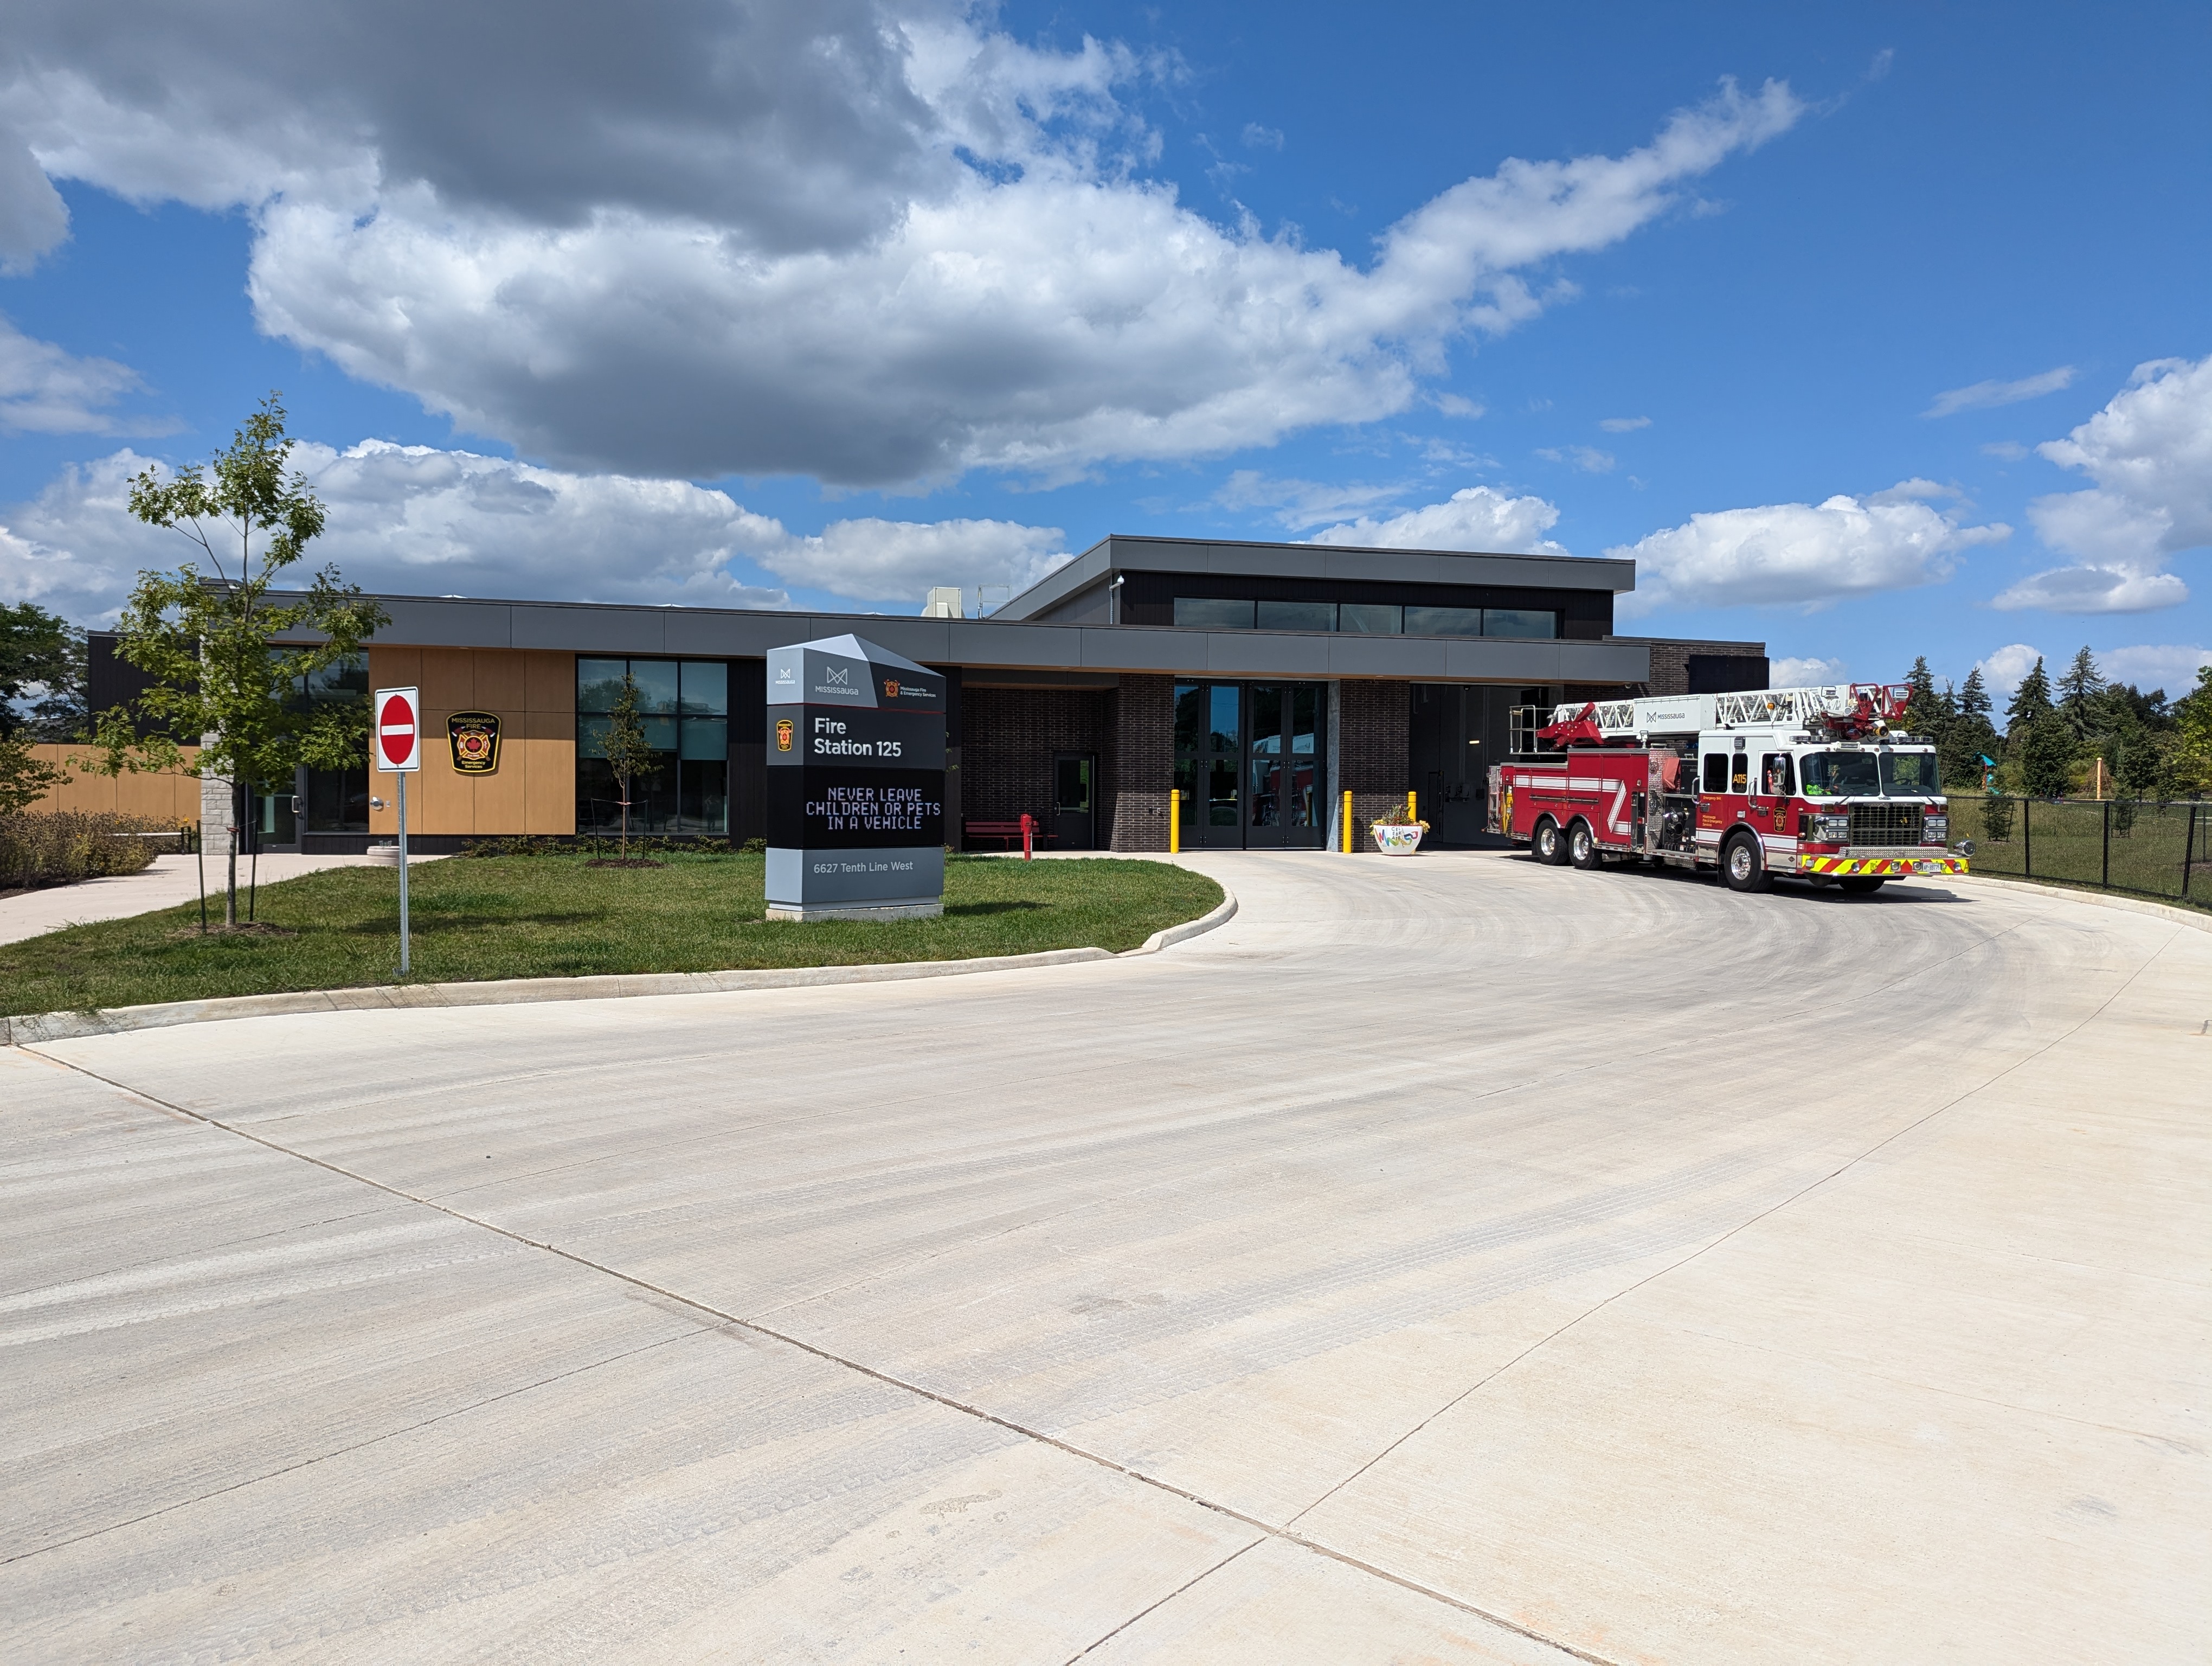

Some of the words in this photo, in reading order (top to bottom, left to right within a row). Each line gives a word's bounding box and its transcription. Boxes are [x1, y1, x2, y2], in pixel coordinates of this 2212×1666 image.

[814, 717, 846, 734] Fire
[814, 738, 872, 755] Station
[876, 741, 902, 757] 125
[1732, 774, 1747, 784] A115
[828, 787, 874, 802] NEVER
[880, 788, 922, 802] LEAVE
[806, 802, 878, 815] CHILDREN
[884, 802, 901, 815] OR
[907, 803, 941, 816] PETS
[828, 816, 843, 830] IN
[850, 816, 858, 830] A
[864, 816, 922, 829] VEHICLE
[814, 863, 838, 874] 6627
[841, 863, 866, 873] Tenth
[869, 861, 888, 872] Line
[891, 861, 914, 871] West
